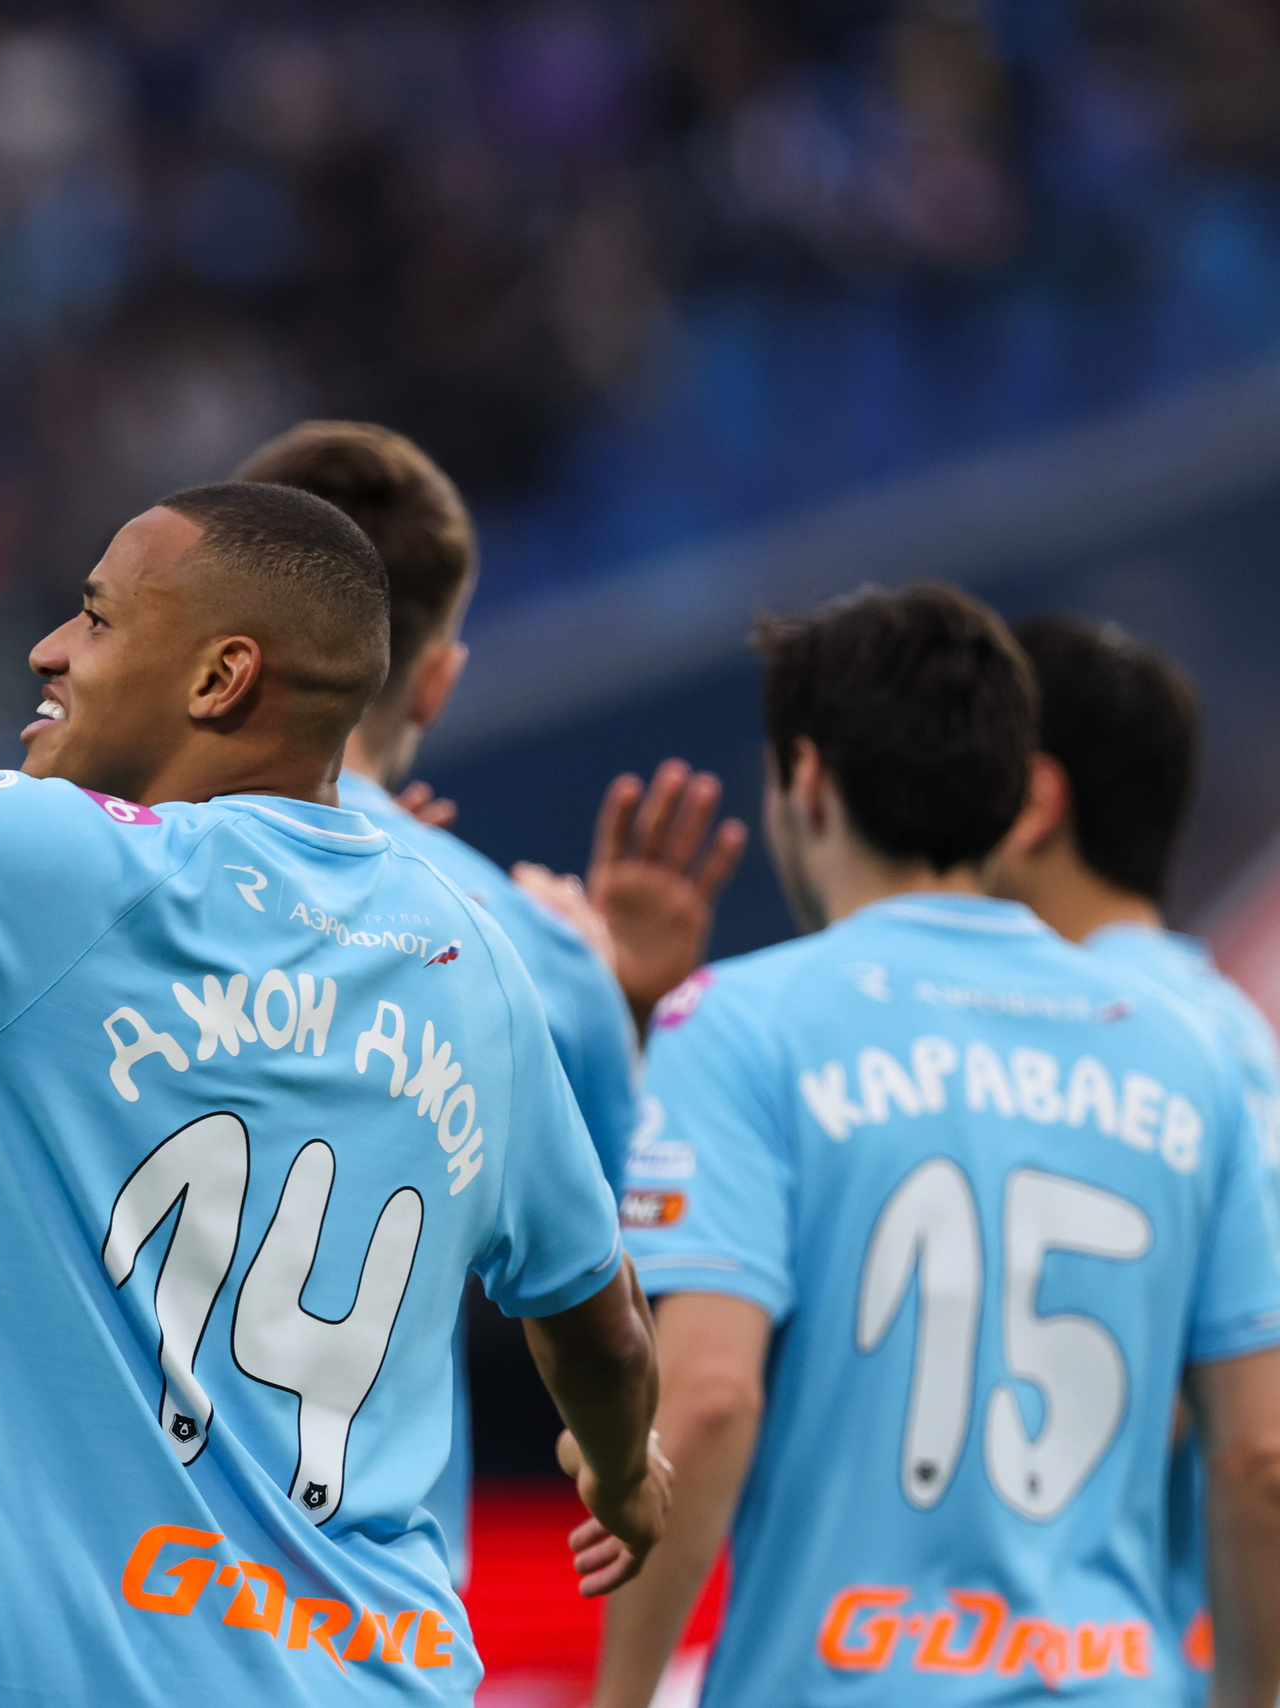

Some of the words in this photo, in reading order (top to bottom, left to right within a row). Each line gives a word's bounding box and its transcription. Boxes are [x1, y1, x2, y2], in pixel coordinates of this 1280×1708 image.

[289, 901, 433, 959] АЭРОФЛОТ
[364, 913, 432, 928] ГРУППА
[102, 968, 338, 1102] ДЖОН
[354, 999, 484, 1197] ДЖОН
[800, 1036, 1204, 1174] КАРАВАЕВ
[101, 1110, 425, 1527] 14
[853, 1155, 1154, 1523] 15
